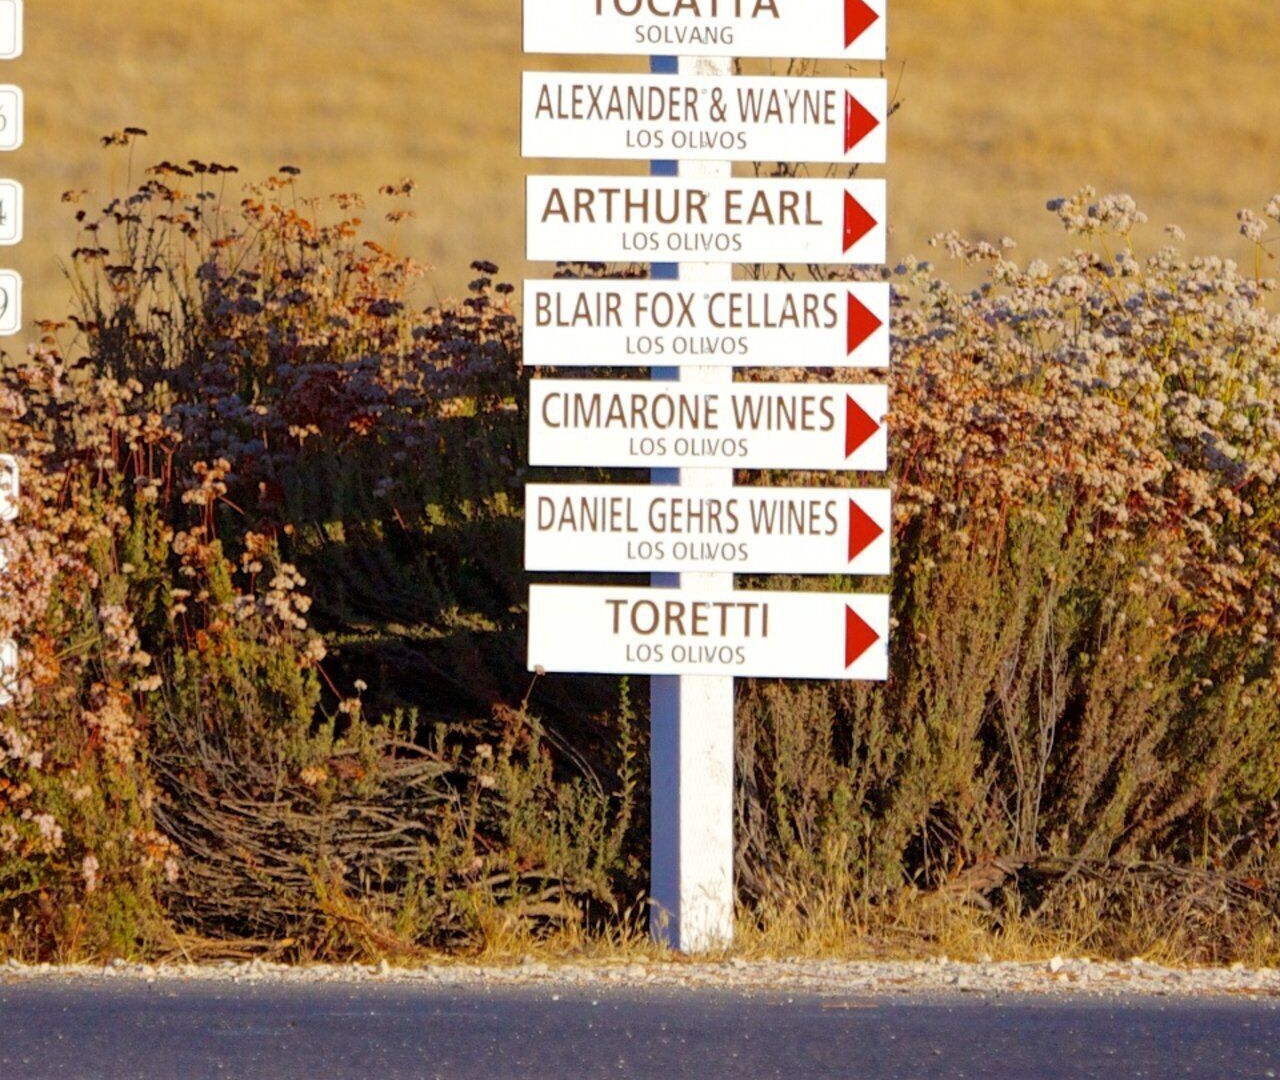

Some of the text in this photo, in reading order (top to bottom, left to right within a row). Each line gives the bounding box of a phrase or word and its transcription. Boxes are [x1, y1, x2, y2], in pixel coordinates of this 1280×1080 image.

[635, 25, 734, 44] SOLVANG
[535, 84, 836, 124] ALEXANDER & WAYNE
[626, 130, 747, 149] LOS OLIVOS
[541, 188, 823, 226] ARTHUR EARL
[622, 232, 743, 251] LOS OLIVOS
[535, 292, 838, 329] BLAIR FOX CELLARS
[626, 336, 749, 355] LOS OLIVOS
[541, 393, 835, 432] CIMARONE WINES
[629, 437, 749, 457] LOS OLIVOS
[537, 497, 838, 536] DANIEL GEHRS WINES
[627, 541, 749, 561] LOS OLIVOS
[605, 599, 769, 638] TORETTI
[626, 644, 745, 664] LOS OLIVOS
